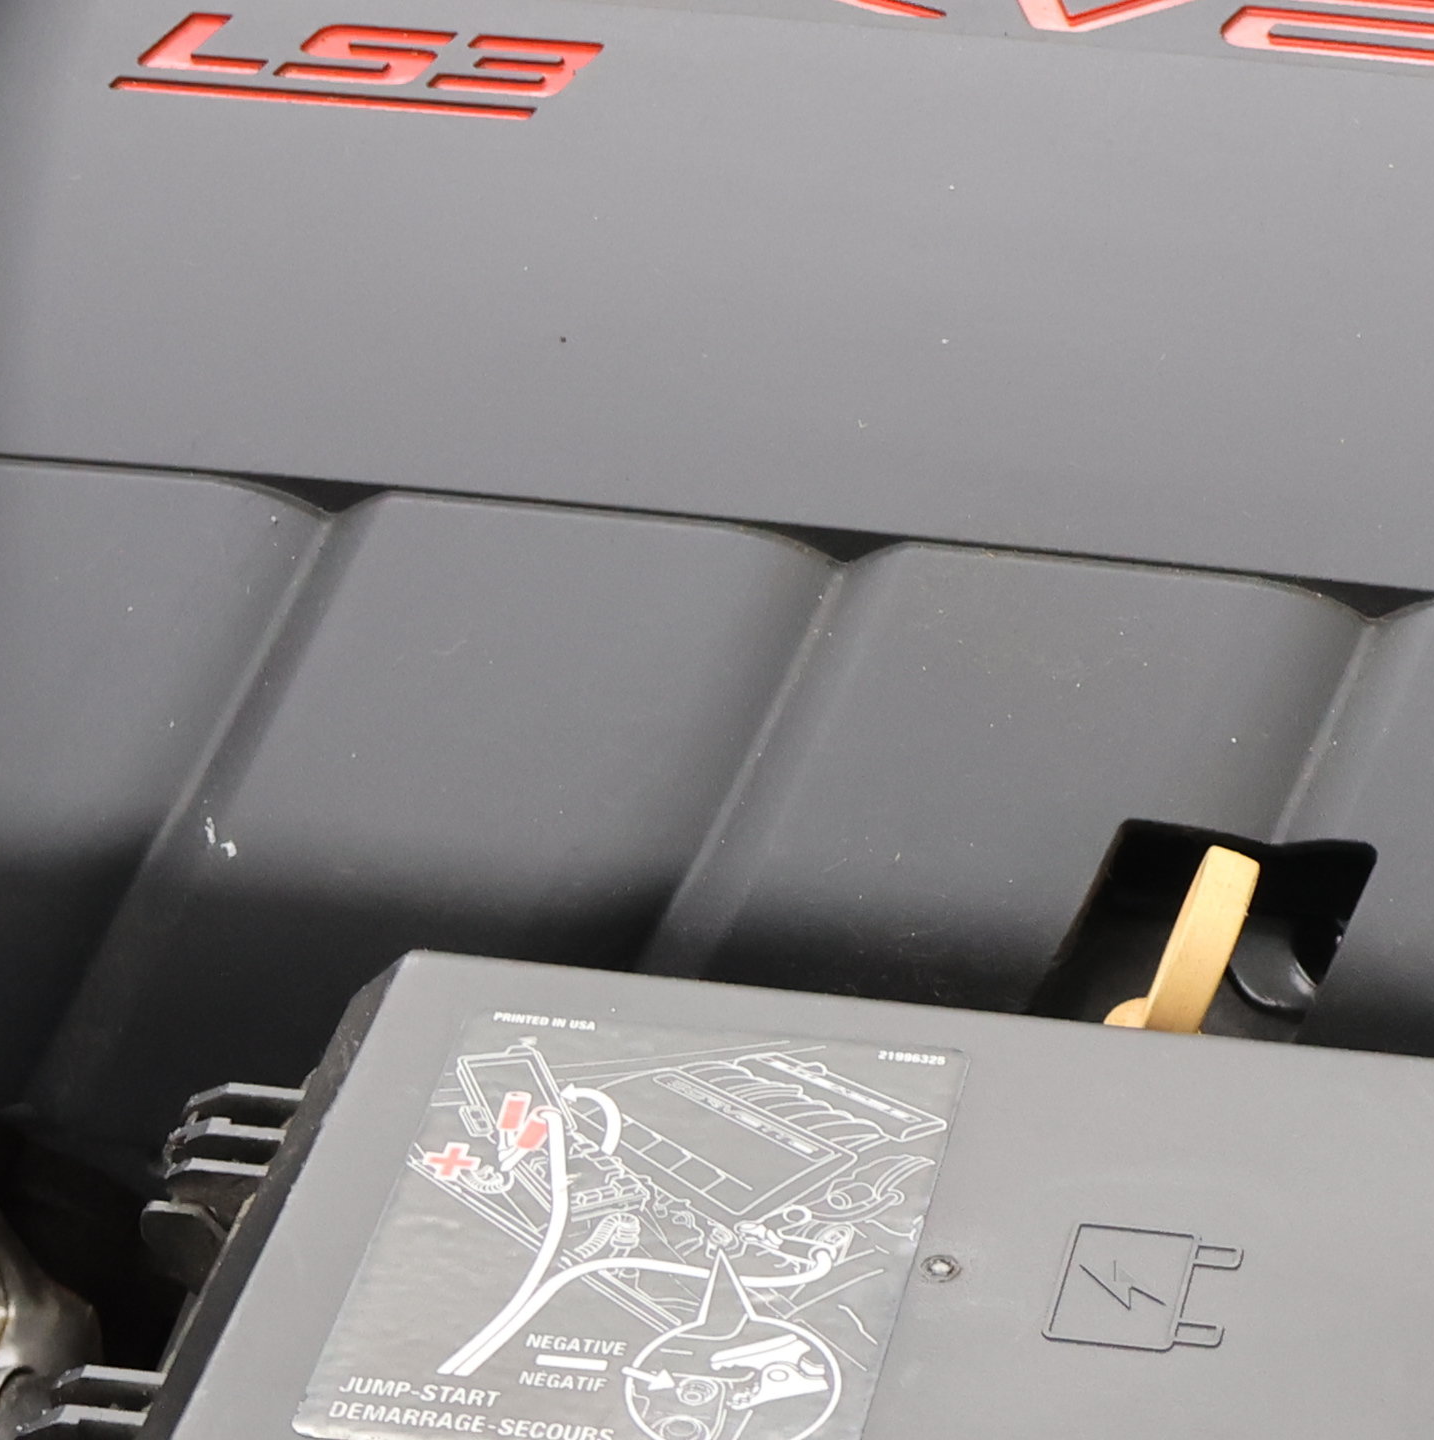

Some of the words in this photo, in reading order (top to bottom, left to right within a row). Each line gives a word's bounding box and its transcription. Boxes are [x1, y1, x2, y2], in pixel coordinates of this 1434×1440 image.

[137, 12, 604, 100] LS3
[493, 1011, 550, 1028] PRINTED
[552, 1017, 566, 1029] IN
[568, 1019, 596, 1032] USA
[525, 1333, 627, 1357] NEGATIVE
[339, 1376, 500, 1408] JUMP-START
[519, 1369, 607, 1392] NÉGATIF
